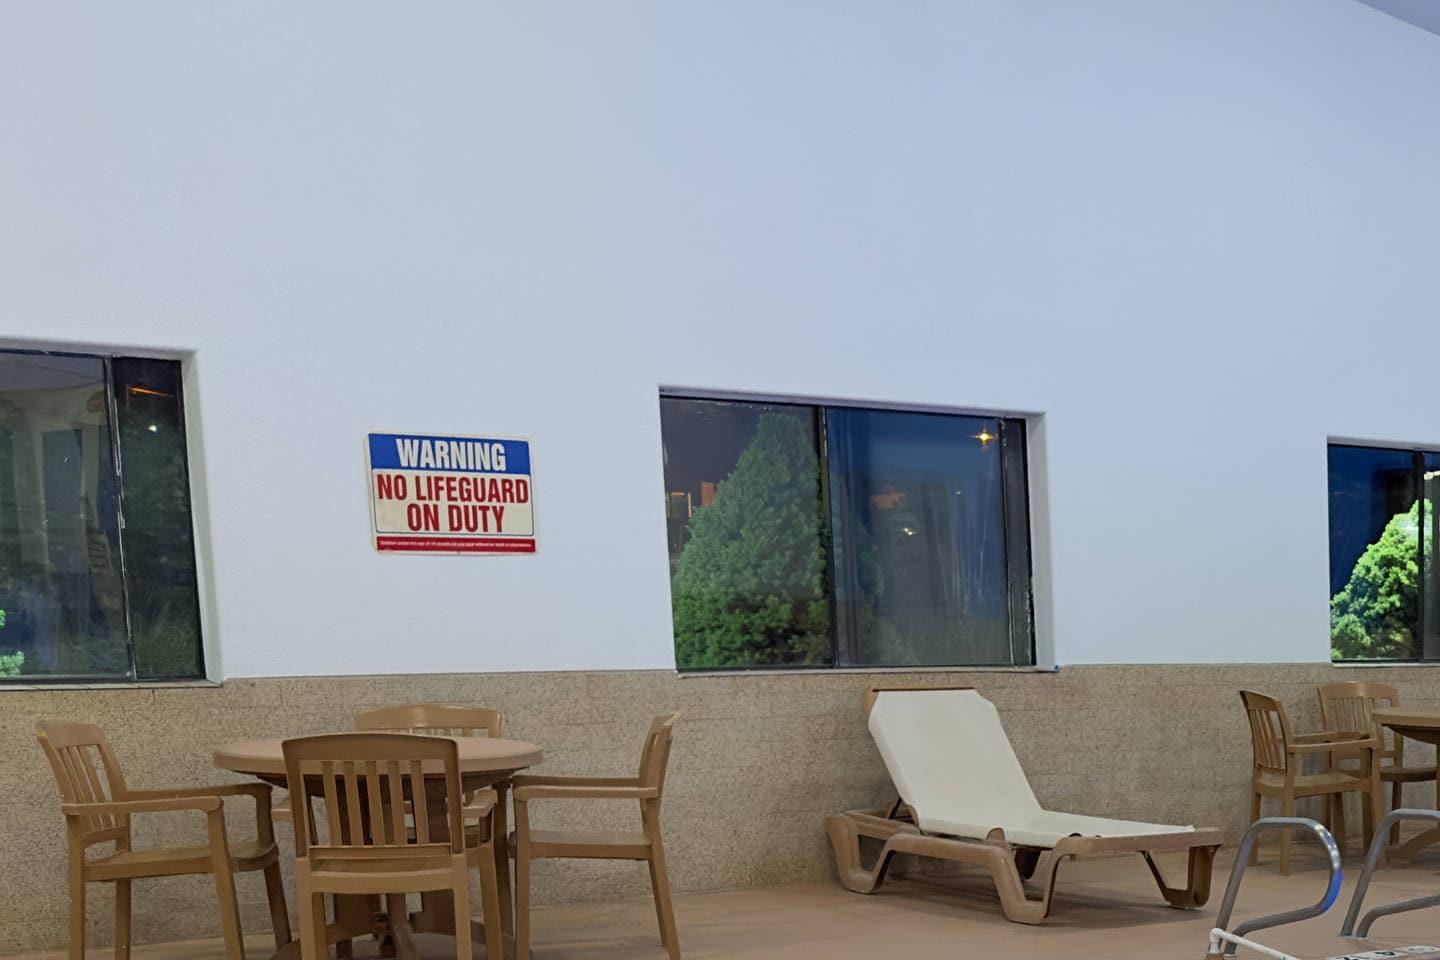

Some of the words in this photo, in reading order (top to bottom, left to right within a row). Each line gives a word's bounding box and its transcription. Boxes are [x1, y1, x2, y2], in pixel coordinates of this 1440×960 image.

[396, 438, 506, 472] WARNING
[376, 474, 408, 501] NO
[415, 475, 529, 504] LIFEGUARD
[407, 503, 440, 531] ON
[448, 504, 504, 533] DUTY
